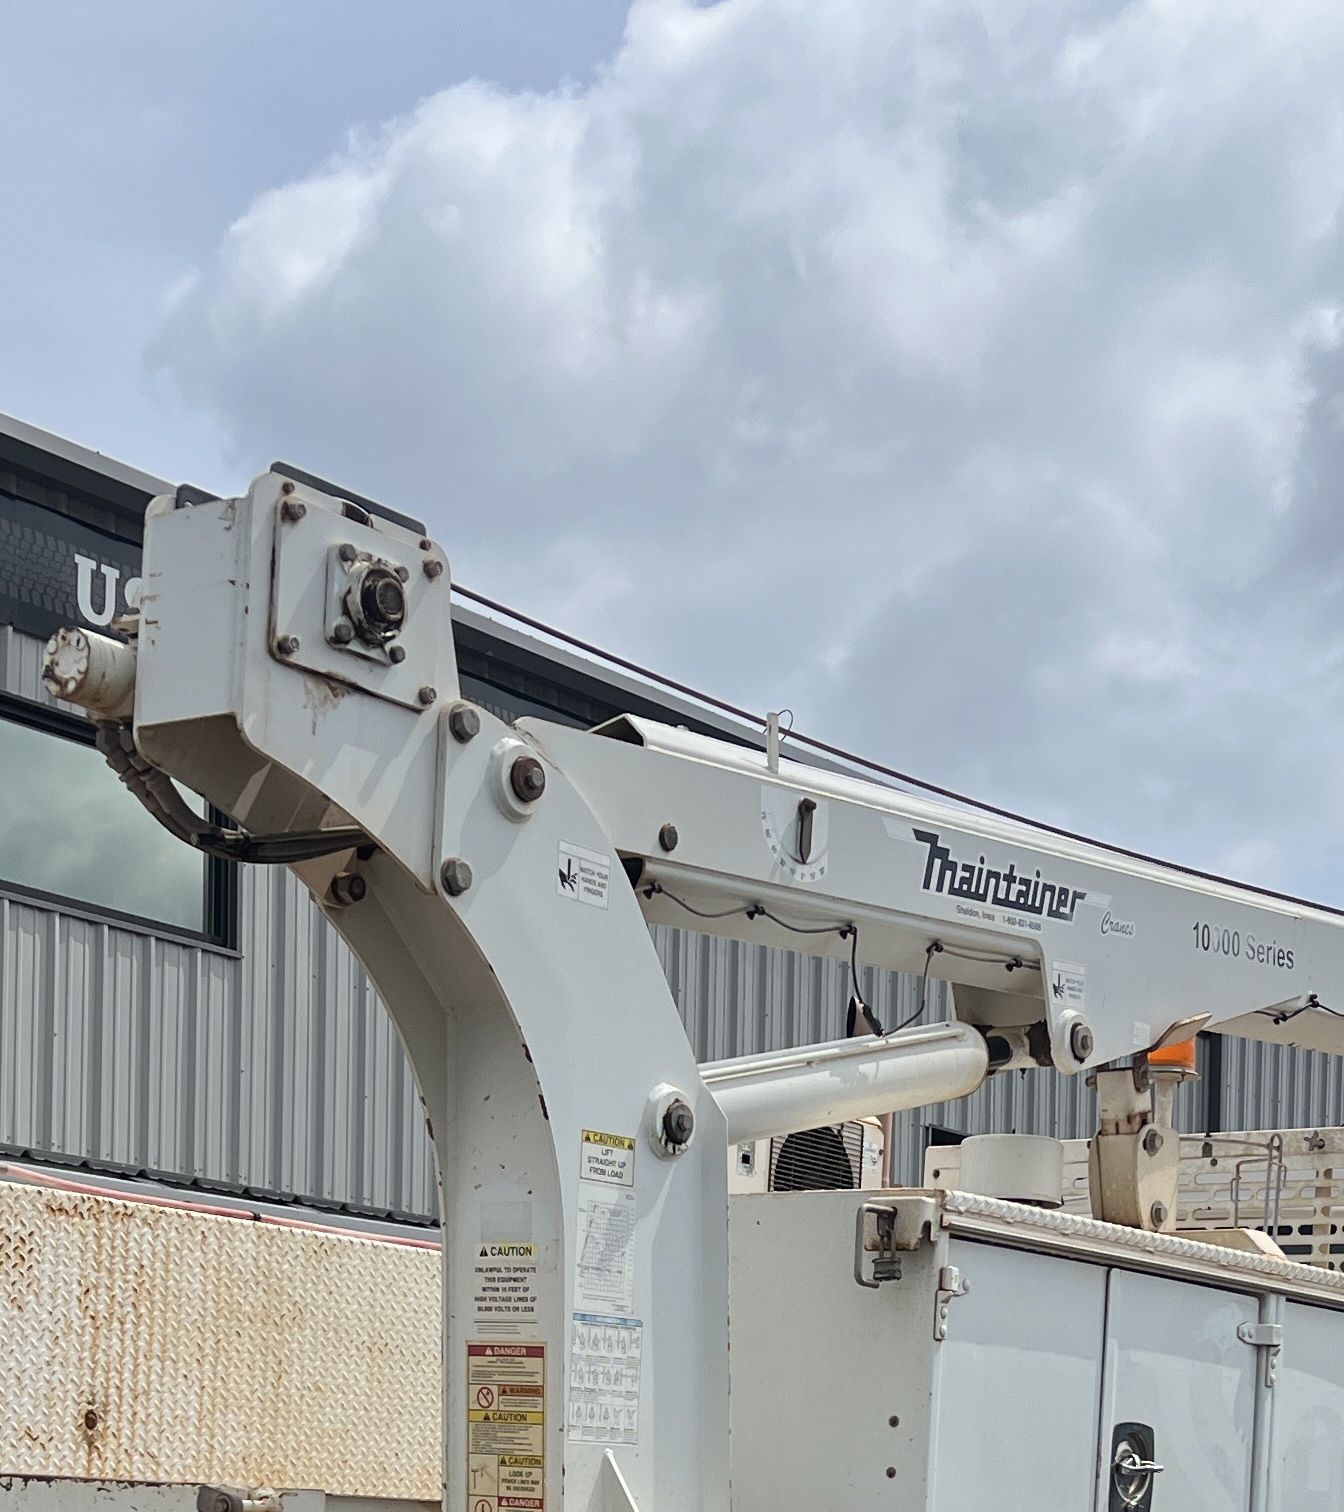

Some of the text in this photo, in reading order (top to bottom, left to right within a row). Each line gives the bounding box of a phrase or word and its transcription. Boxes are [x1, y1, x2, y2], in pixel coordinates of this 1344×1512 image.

[912, 828, 1087, 922] Maintainer
[1101, 910, 1134, 936] Cranes
[1193, 922, 1294, 970] 10000 Series
[593, 1134, 625, 1148] CAUTION
[601, 1149, 613, 1157] LIFT
[587, 1156, 627, 1169] STRAIGHT UP
[589, 1166, 624, 1179] FROM LOAD
[490, 1246, 533, 1257] CAUTION
[474, 1266, 537, 1274] UNLAWFUL TO OPERATE
[513, 1296, 528, 1304] LINES
[494, 1305, 511, 1313] VOLTS
[511, 1305, 520, 1313] OR
[520, 1306, 535, 1314] LESS
[493, 1346, 527, 1356] DANGER
[508, 1387, 541, 1395] WARNING
[492, 1412, 528, 1422] CAUTION
[508, 1457, 542, 1466] CAUTION
[508, 1470, 533, 1479] LOOK UP
[508, 1499, 540, 1508] DANGER
